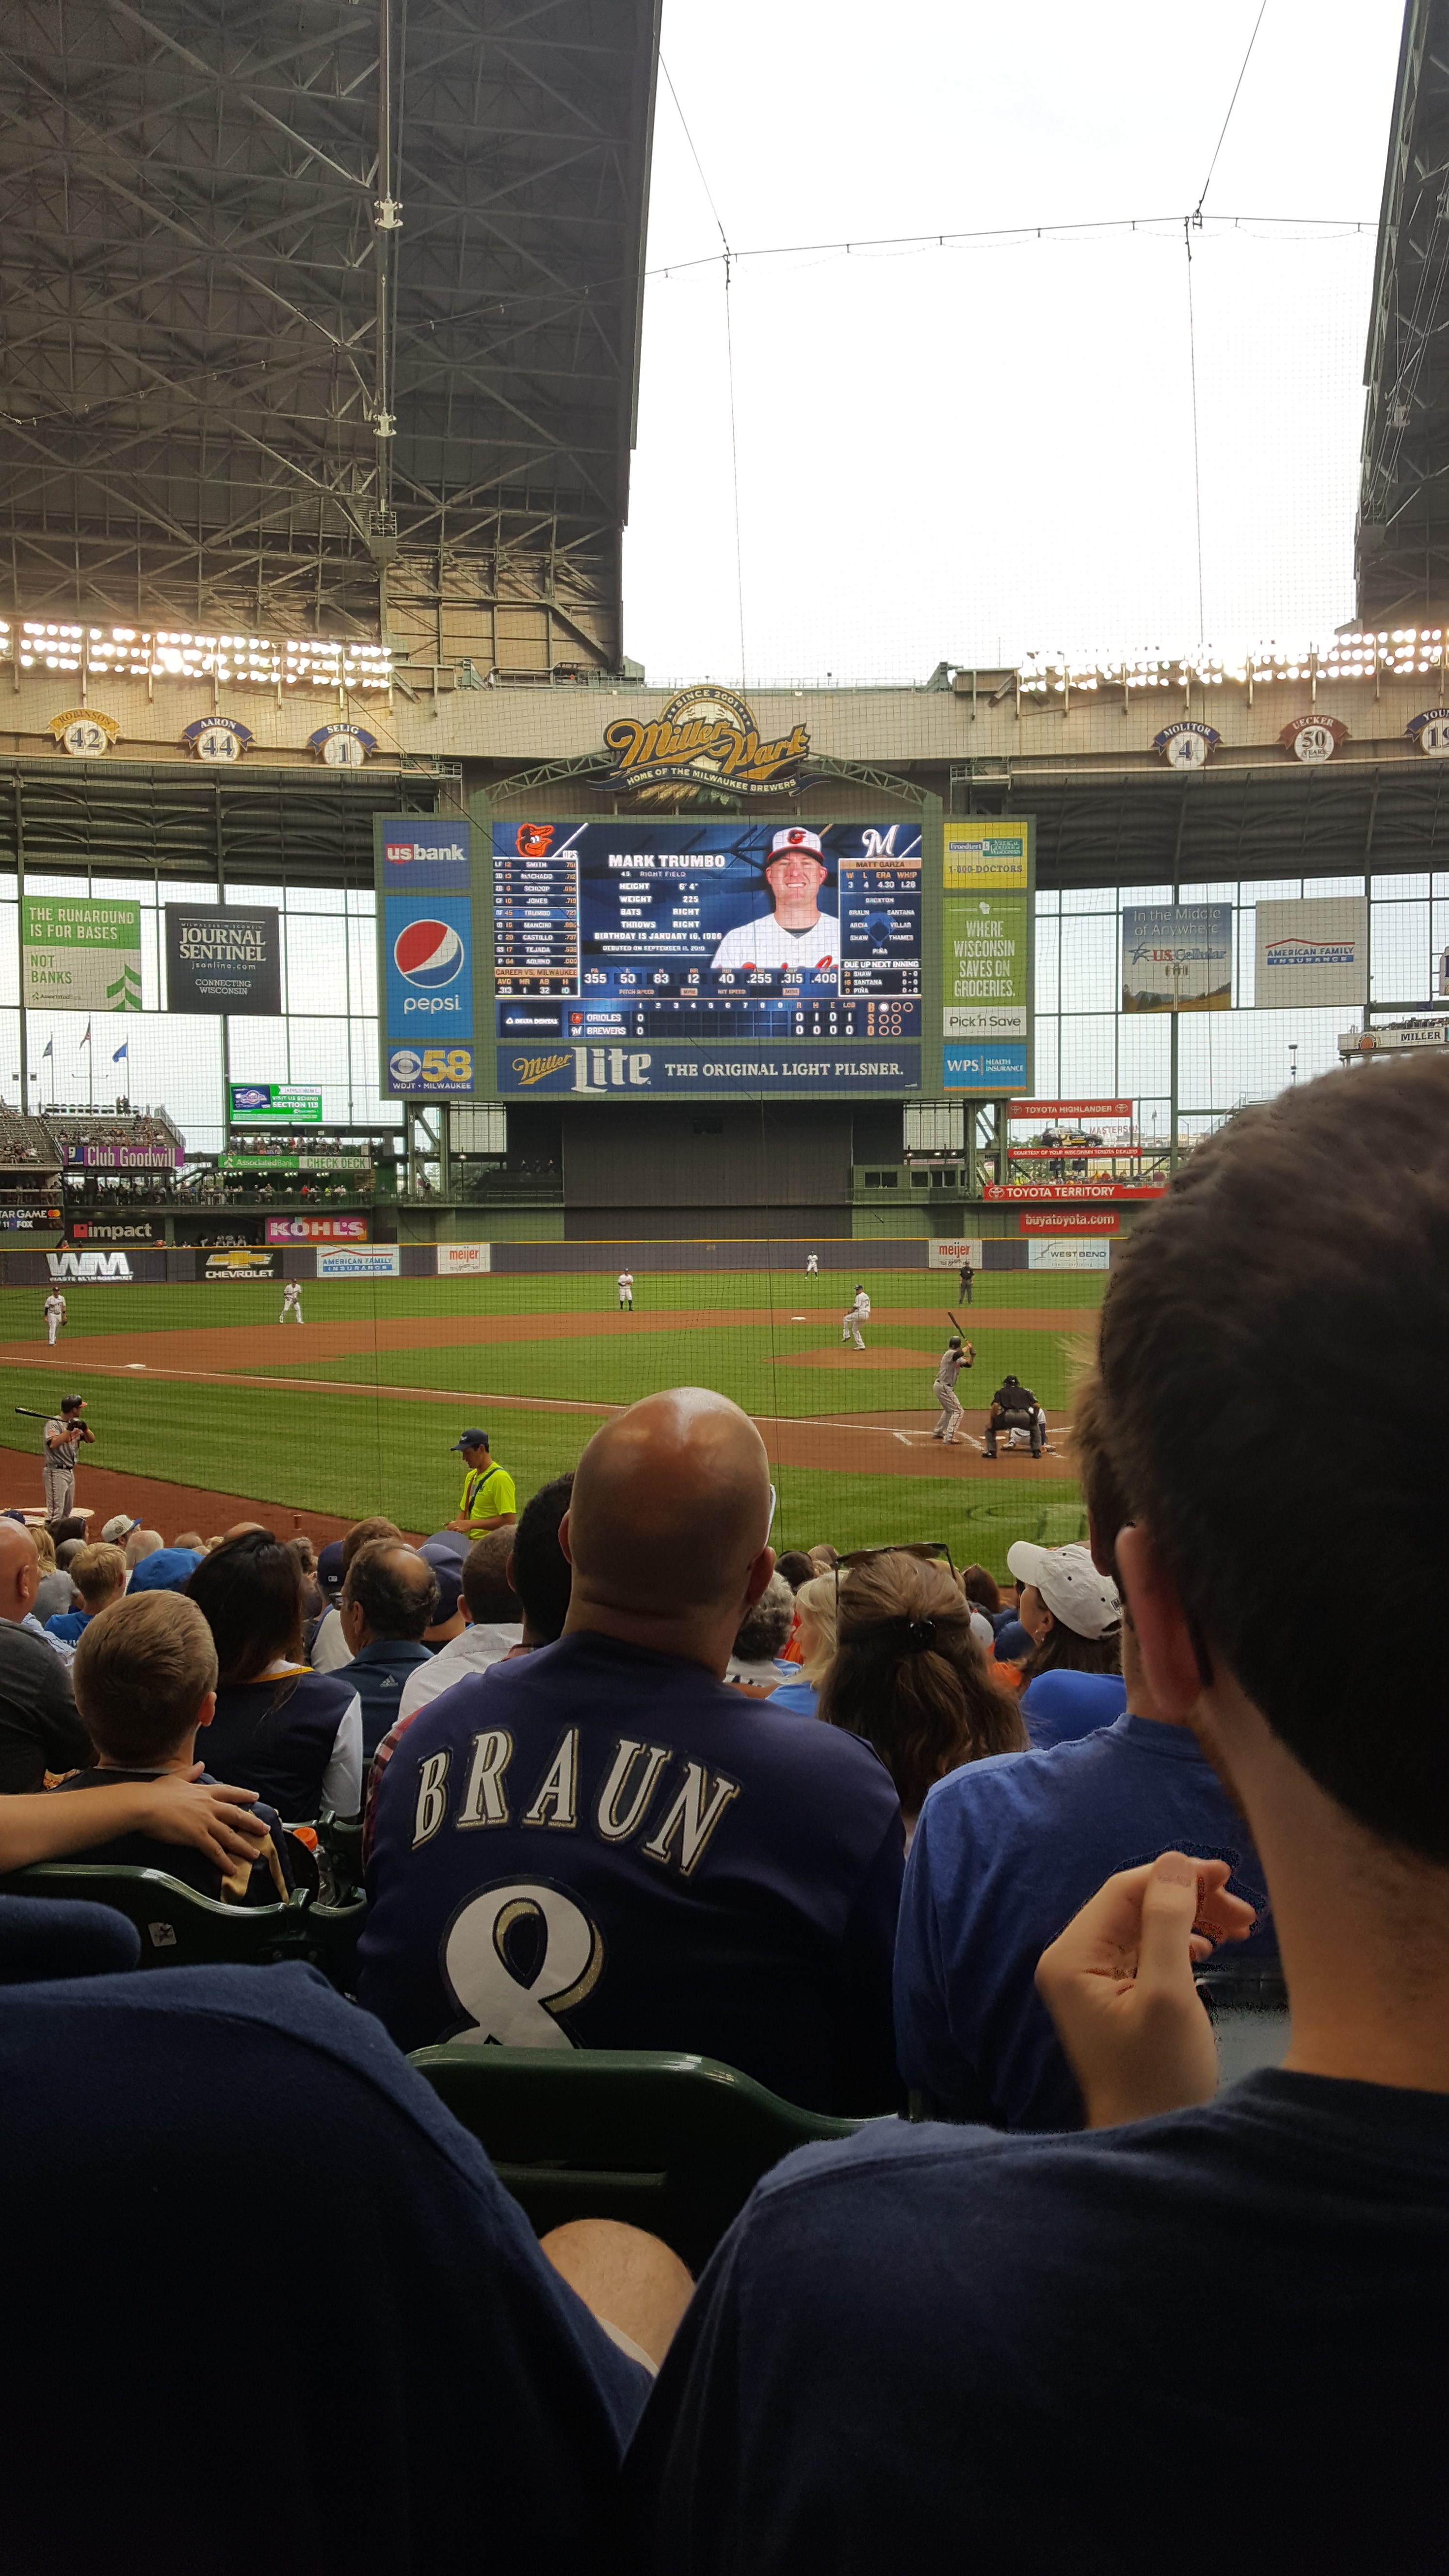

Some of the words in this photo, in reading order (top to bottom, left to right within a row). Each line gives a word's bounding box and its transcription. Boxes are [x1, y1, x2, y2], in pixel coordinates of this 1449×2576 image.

[676, 689, 710, 707] SINCE
[714, 690, 739, 708] 2001
[59, 710, 112, 725] ROBINSON
[200, 718, 237, 730] AARON
[1292, 716, 1334, 730] UECKER
[327, 724, 360, 735] SELIG
[1163, 722, 1211, 738] MOLITOR
[70, 727, 101, 750] 42
[203, 735, 234, 757] 44
[1302, 730, 1326, 749] 50
[338, 742, 351, 763] 1
[606, 720, 731, 769] Miller
[710, 726, 807, 775] Park
[1178, 740, 1193, 761] 4
[627, 770, 653, 786] HOME
[655, 768, 668, 776] OF
[671, 768, 690, 776] THE
[692, 770, 748, 791] MILWAUKEE
[750, 778, 797, 792] BREWERS
[609, 854, 655, 868] MARK
[658, 854, 726, 868] TRUMBO
[949, 865, 1023, 873] 1-800-DOCTORS
[29, 907, 53, 921] THE
[58, 908, 134, 924] RUNAROUND
[1133, 910, 1146, 922] In
[1150, 909, 1172, 921] the
[1175, 907, 1221, 920] Middle
[30, 924, 43, 937] IS
[47, 924, 72, 938] FOR
[77, 925, 118, 940] BASES
[966, 920, 1004, 938] WHERE
[1135, 924, 1148, 936] of
[1151, 922, 1219, 937] Anywhere
[179, 928, 266, 946] JOURNAL
[179, 944, 266, 962] SENTINEL
[953, 939, 1015, 958] WISCONSIN
[1175, 946, 1227, 961] Cellular
[1267, 948, 1317, 957] AMERICAN
[1320, 946, 1354, 955] FAMILY
[30, 954, 55, 968] NOT
[191, 961, 256, 970] jsonline.com
[1273, 956, 1348, 965] INSURANCE
[959, 960, 993, 978] SAVES
[995, 960, 1010, 977] ON
[31, 970, 72, 984] BANKS
[195, 979, 252, 987] CONNECTING
[583, 973, 607, 984] 355
[620, 973, 636, 984] 50
[653, 973, 669, 984] 83
[687, 973, 700, 984] 12
[719, 973, 735, 984] 40
[746, 973, 772, 984] .255
[780, 973, 804, 984] .315
[810, 973, 837, 984] .408
[199, 986, 248, 995] WISCONSIN
[954, 979, 1015, 997] GROCERIES.
[403, 995, 460, 1014] pepsi
[586, 1014, 622, 1022] ORIOLES
[989, 1016, 1021, 1027] Save
[586, 1027, 627, 1035] BREWERS
[1401, 1031, 1442, 1042] MILLER
[420, 1049, 472, 1082] 58
[512, 1053, 573, 1083] Miller
[570, 1046, 652, 1094] Lite
[665, 1063, 699, 1077] THE
[702, 1063, 778, 1077] ORIGINAL
[782, 1063, 831, 1076] LIGHT
[835, 1063, 904, 1076] PILSNER.
[947, 1059, 979, 1072] WPS
[87, 1146, 115, 1167] Club
[119, 1145, 176, 1168] Goodwill
[306, 1158, 338, 1169] CHECK
[341, 1158, 365, 1169] DECK
[1006, 1187, 1052, 1198] TOYOTA
[1054, 1186, 1115, 1197] TERRITORY
[16, 1209, 48, 1219] GAME
[1025, 1213, 1115, 1227] buyatoyota.com
[16, 1220, 34, 1229] FOX
[88, 1221, 152, 1240] impact
[270, 1221, 365, 1237] KOHL'S
[449, 1246, 480, 1263] meijer
[939, 1241, 970, 1258] meijer
[46, 1252, 131, 1276] WM
[322, 1257, 363, 1266] AMERICAN
[205, 1269, 274, 1279] CHEVROLET
[411, 1725, 741, 1879] BRAUN
[445, 1884, 604, 2050] 8
